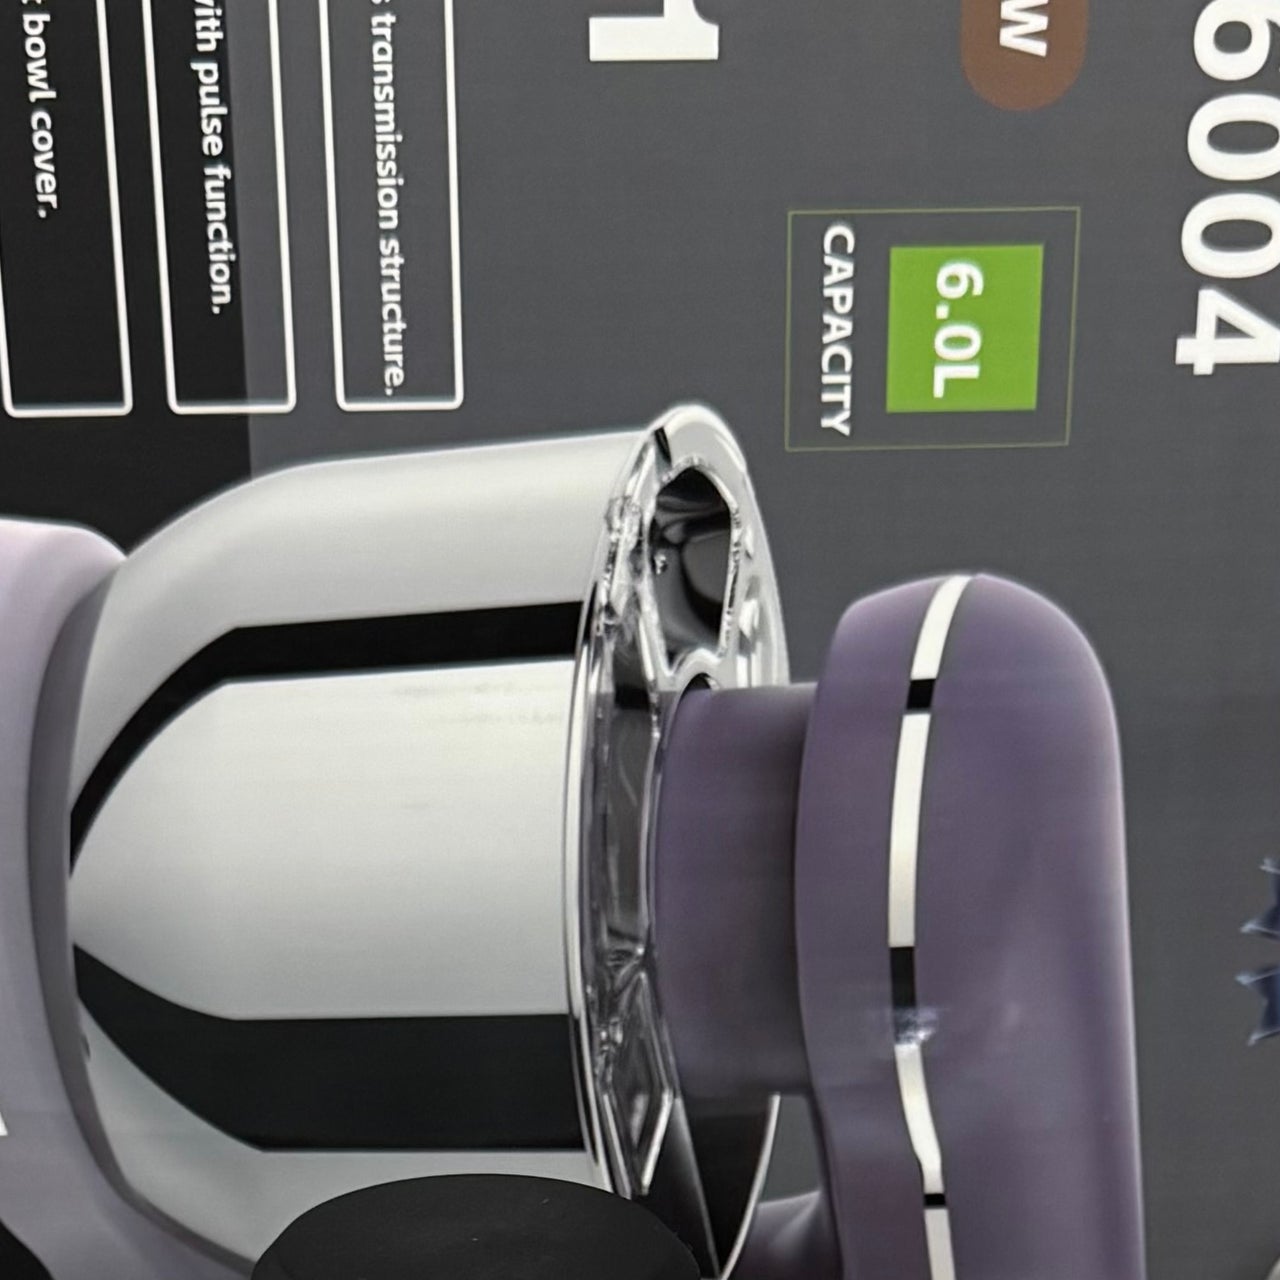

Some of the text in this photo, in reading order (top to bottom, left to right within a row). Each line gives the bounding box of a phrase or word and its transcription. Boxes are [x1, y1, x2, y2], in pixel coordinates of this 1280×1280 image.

[22, 13, 57, 102] bowl
[371, 13, 404, 229] transmission
[30, 110, 58, 219] cover.
[190, 0, 236, 315] ith pulse function.
[379, 237, 407, 396] structure.
[820, 222, 855, 437] CAPACITY
[933, 260, 984, 398] 6.0L
